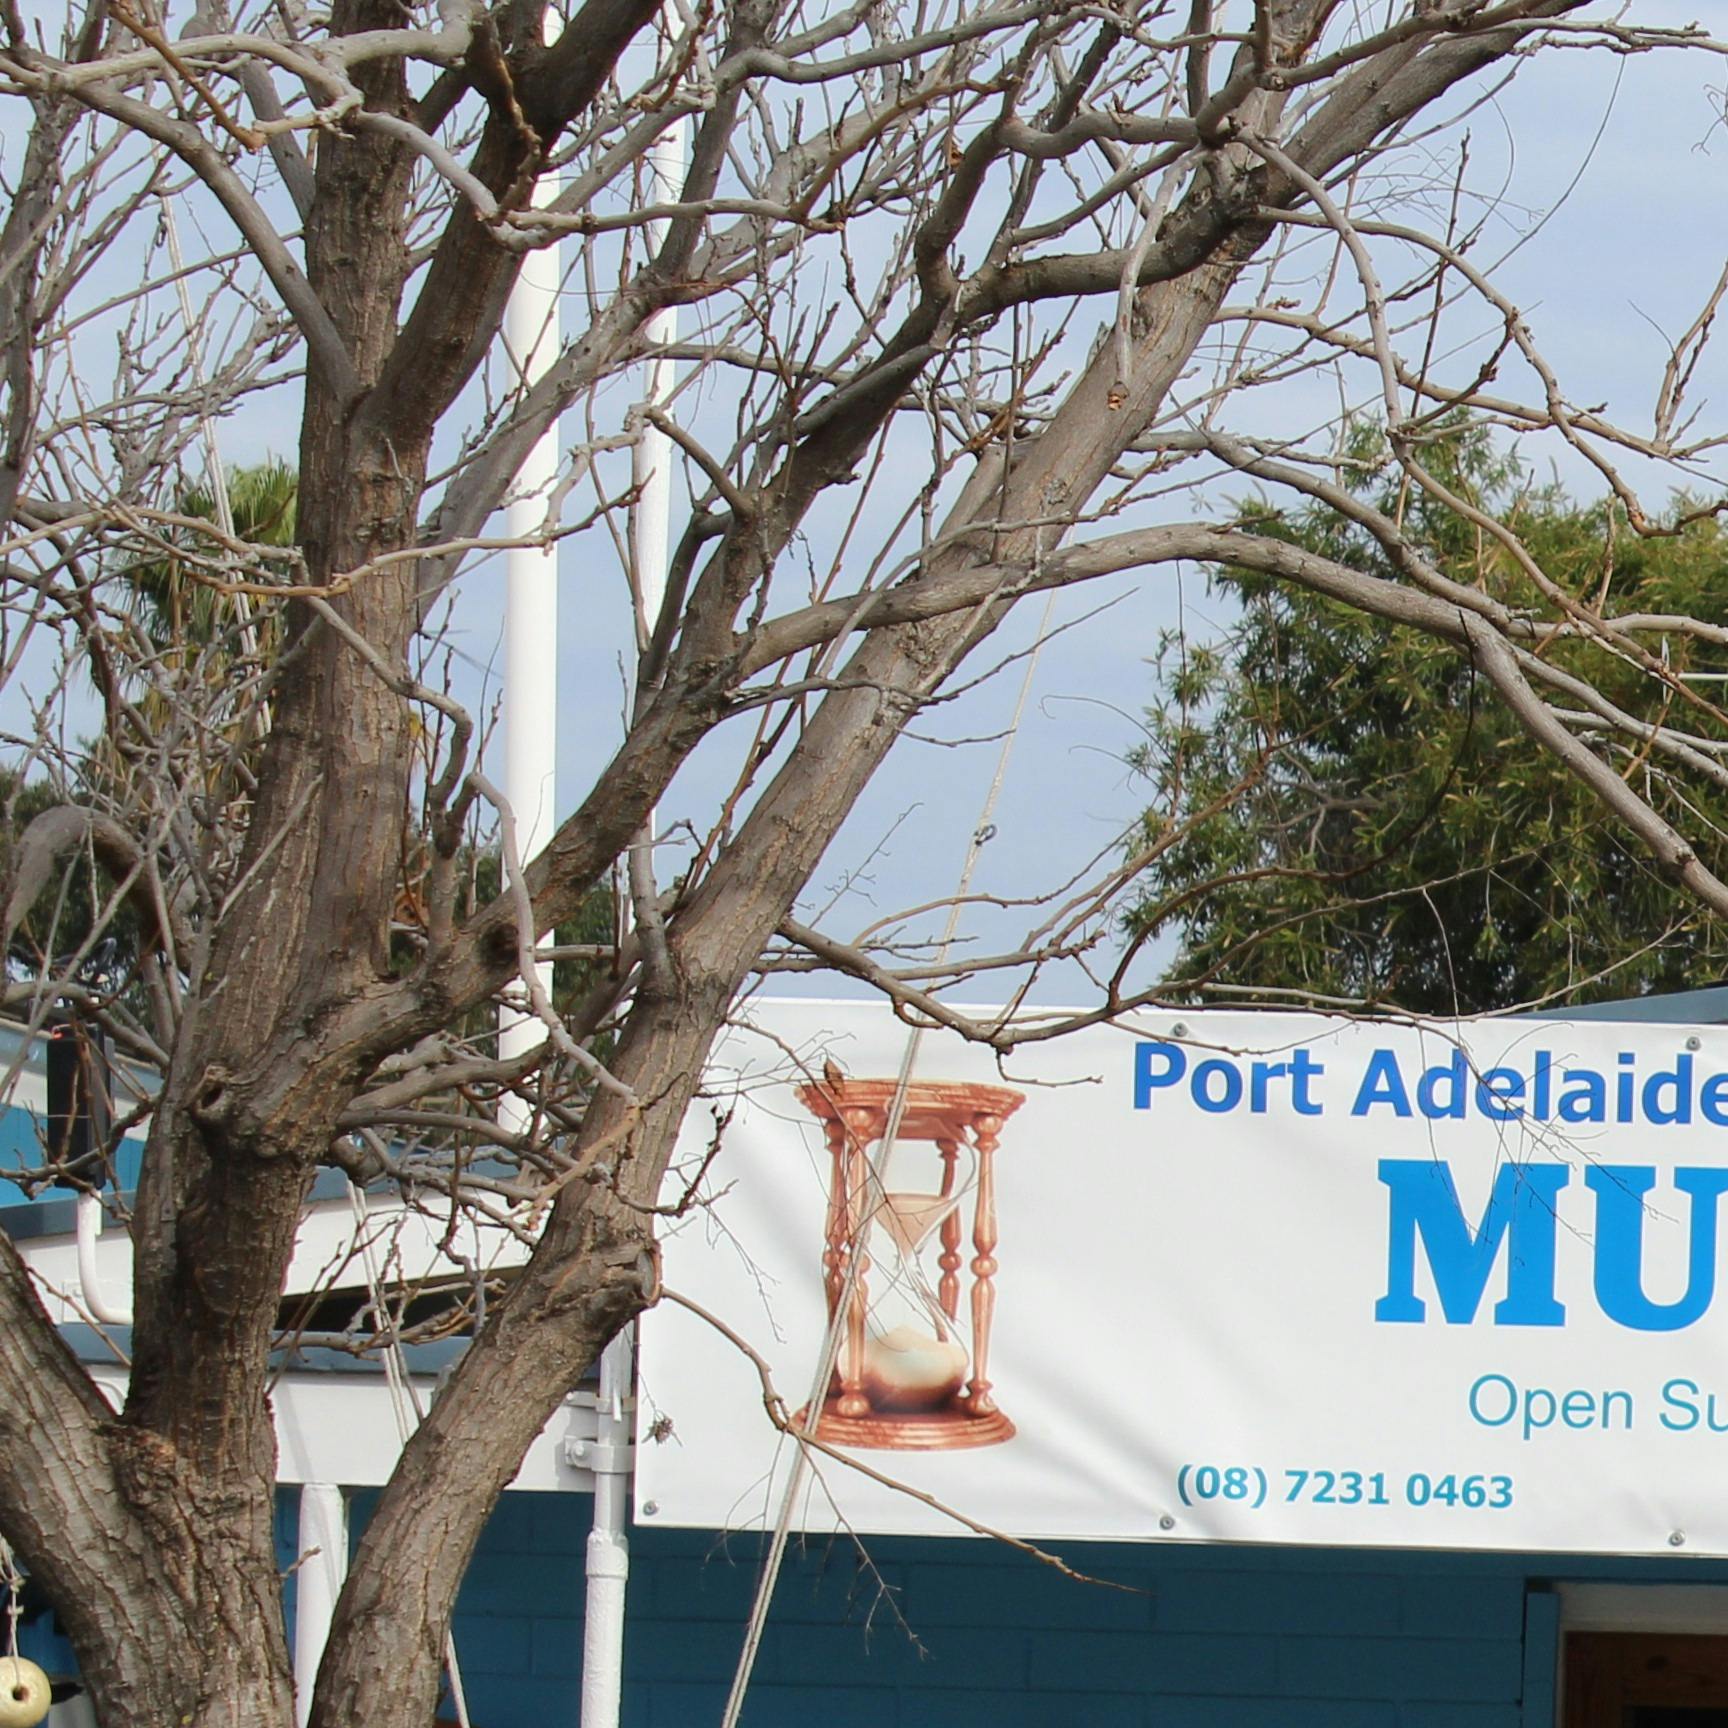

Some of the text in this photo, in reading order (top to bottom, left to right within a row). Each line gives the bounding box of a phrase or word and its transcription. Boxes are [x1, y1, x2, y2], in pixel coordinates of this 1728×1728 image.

[1134, 1042, 1324, 1116] Port
[1470, 1373, 1634, 1440] Open
[1176, 1461, 1515, 1511] (08) 7231 0463
